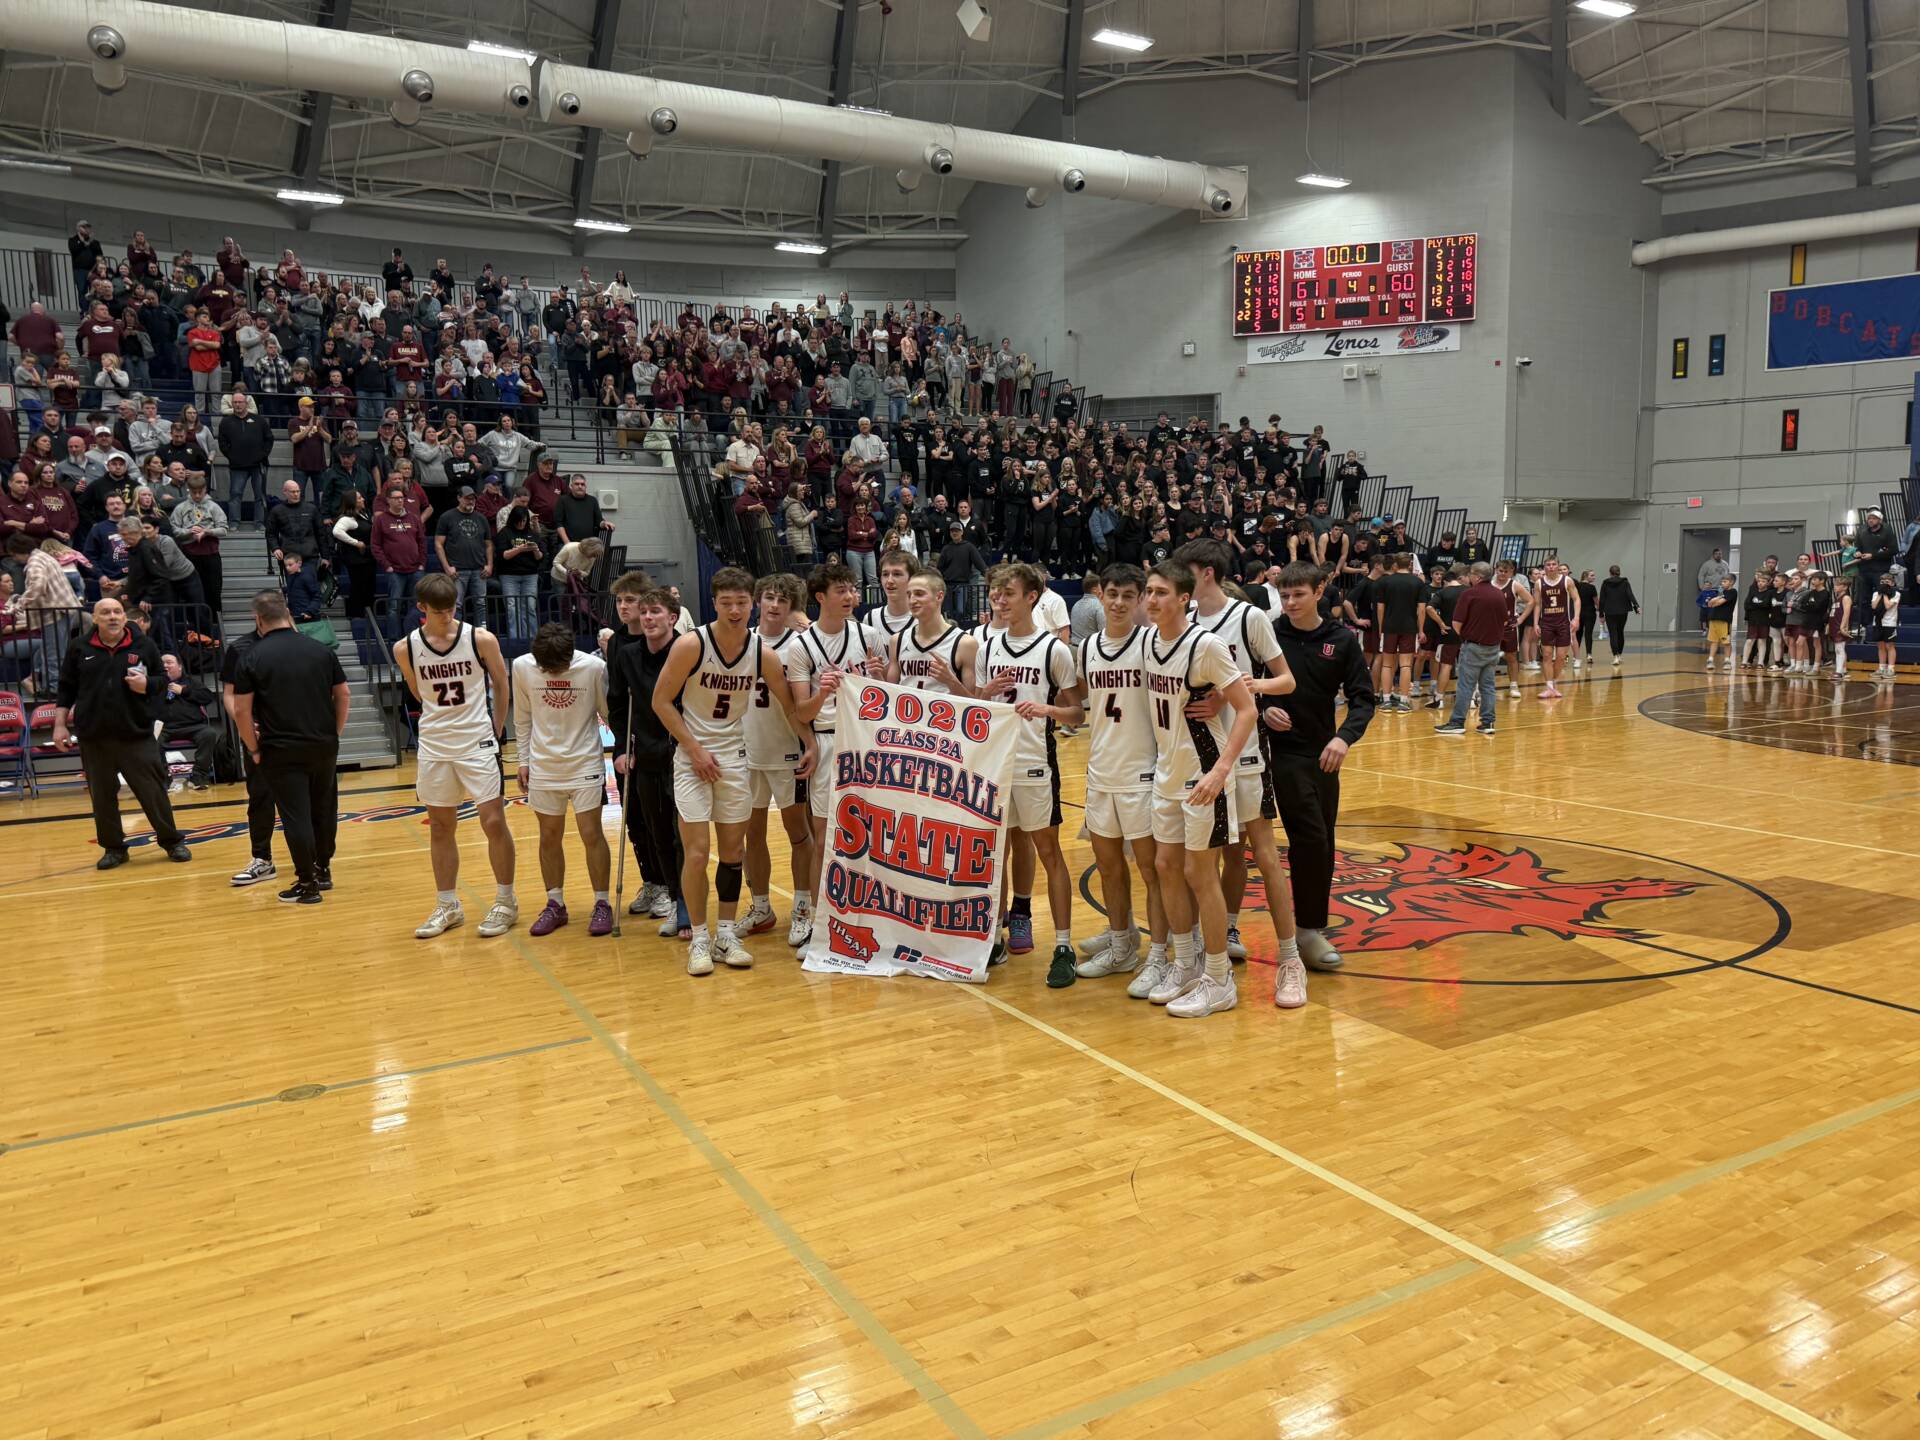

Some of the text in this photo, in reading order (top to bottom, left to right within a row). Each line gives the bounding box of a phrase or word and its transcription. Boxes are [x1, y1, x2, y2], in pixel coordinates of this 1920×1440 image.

[1428, 236, 1475, 248] PLY FL PTS
[1237, 252, 1280, 263] PLY FL PTS
[1436, 249, 1443, 259] 2
[1466, 246, 1473, 257] 0
[1255, 263, 1262, 273] 2
[1268, 263, 1279, 272] 11
[1386, 262, 1414, 273] GUEST
[1437, 258, 1473, 271] 3 2 15
[1245, 275, 1251, 286] 2
[1268, 274, 1279, 284] 12
[1293, 270, 1317, 279] HOME
[1436, 270, 1473, 282] 4 2 18
[1348, 280, 1356, 292] 4
[1391, 273, 1414, 291] 60
[1245, 285, 1279, 296] 4 4 15
[1296, 281, 1319, 299] 61
[1432, 285, 1443, 295] 13
[1462, 283, 1472, 292] 14
[1245, 298, 1279, 309] 5 3 14
[1404, 300, 1413, 312] 4
[1432, 294, 1473, 307] 15 2 3
[1237, 309, 1279, 321] 22 3 6
[1295, 308, 1304, 321] 5
[1446, 308, 1453, 317] 4
[1254, 321, 1261, 331] 5
[1320, 332, 1381, 357] Zenos
[1550, 596, 1557, 607] 3
[419, 661, 472, 680] KNIGHTS
[700, 672, 753, 691] KNIGHTS
[1088, 669, 1141, 690] KNIGHTS
[433, 681, 466, 706] 23
[712, 694, 730, 719] 5
[1104, 694, 1121, 723] 4
[858, 685, 992, 743] 2026
[1156, 698, 1170, 730] 11
[875, 726, 963, 763] CLASS 2A
[835, 748, 1005, 826] BASKETBALL
[833, 793, 997, 889] STATE
[825, 860, 993, 941] QUALIFIER
[832, 921, 868, 957] IHSAA
